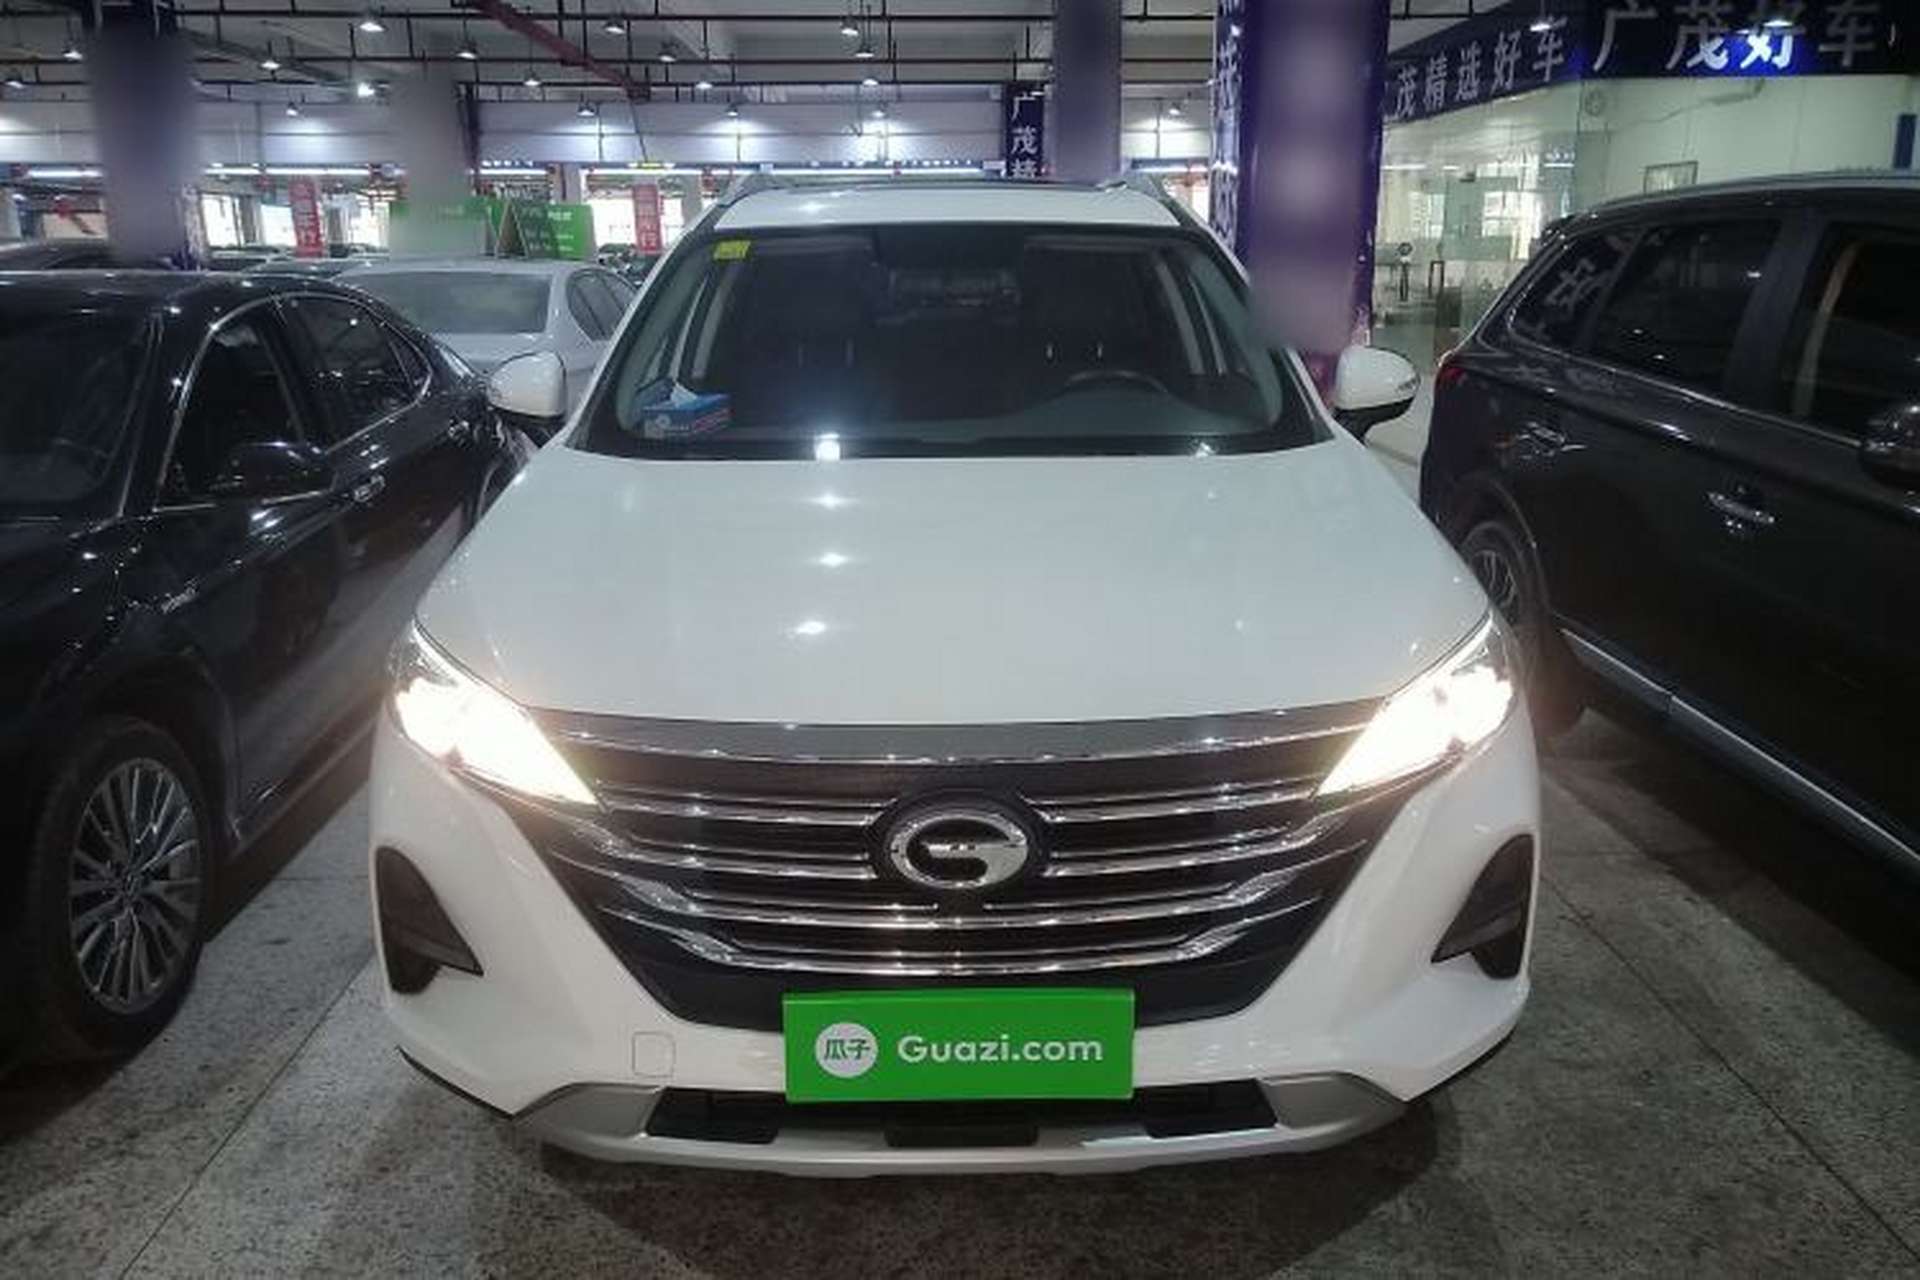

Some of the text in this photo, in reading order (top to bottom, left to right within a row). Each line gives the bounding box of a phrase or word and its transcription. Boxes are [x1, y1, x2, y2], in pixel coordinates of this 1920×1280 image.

[1593, 0, 1880, 70] 广茂好车
[823, 1038, 871, 1061] 瓜子
[897, 1034, 1103, 1063] Guazi.com
